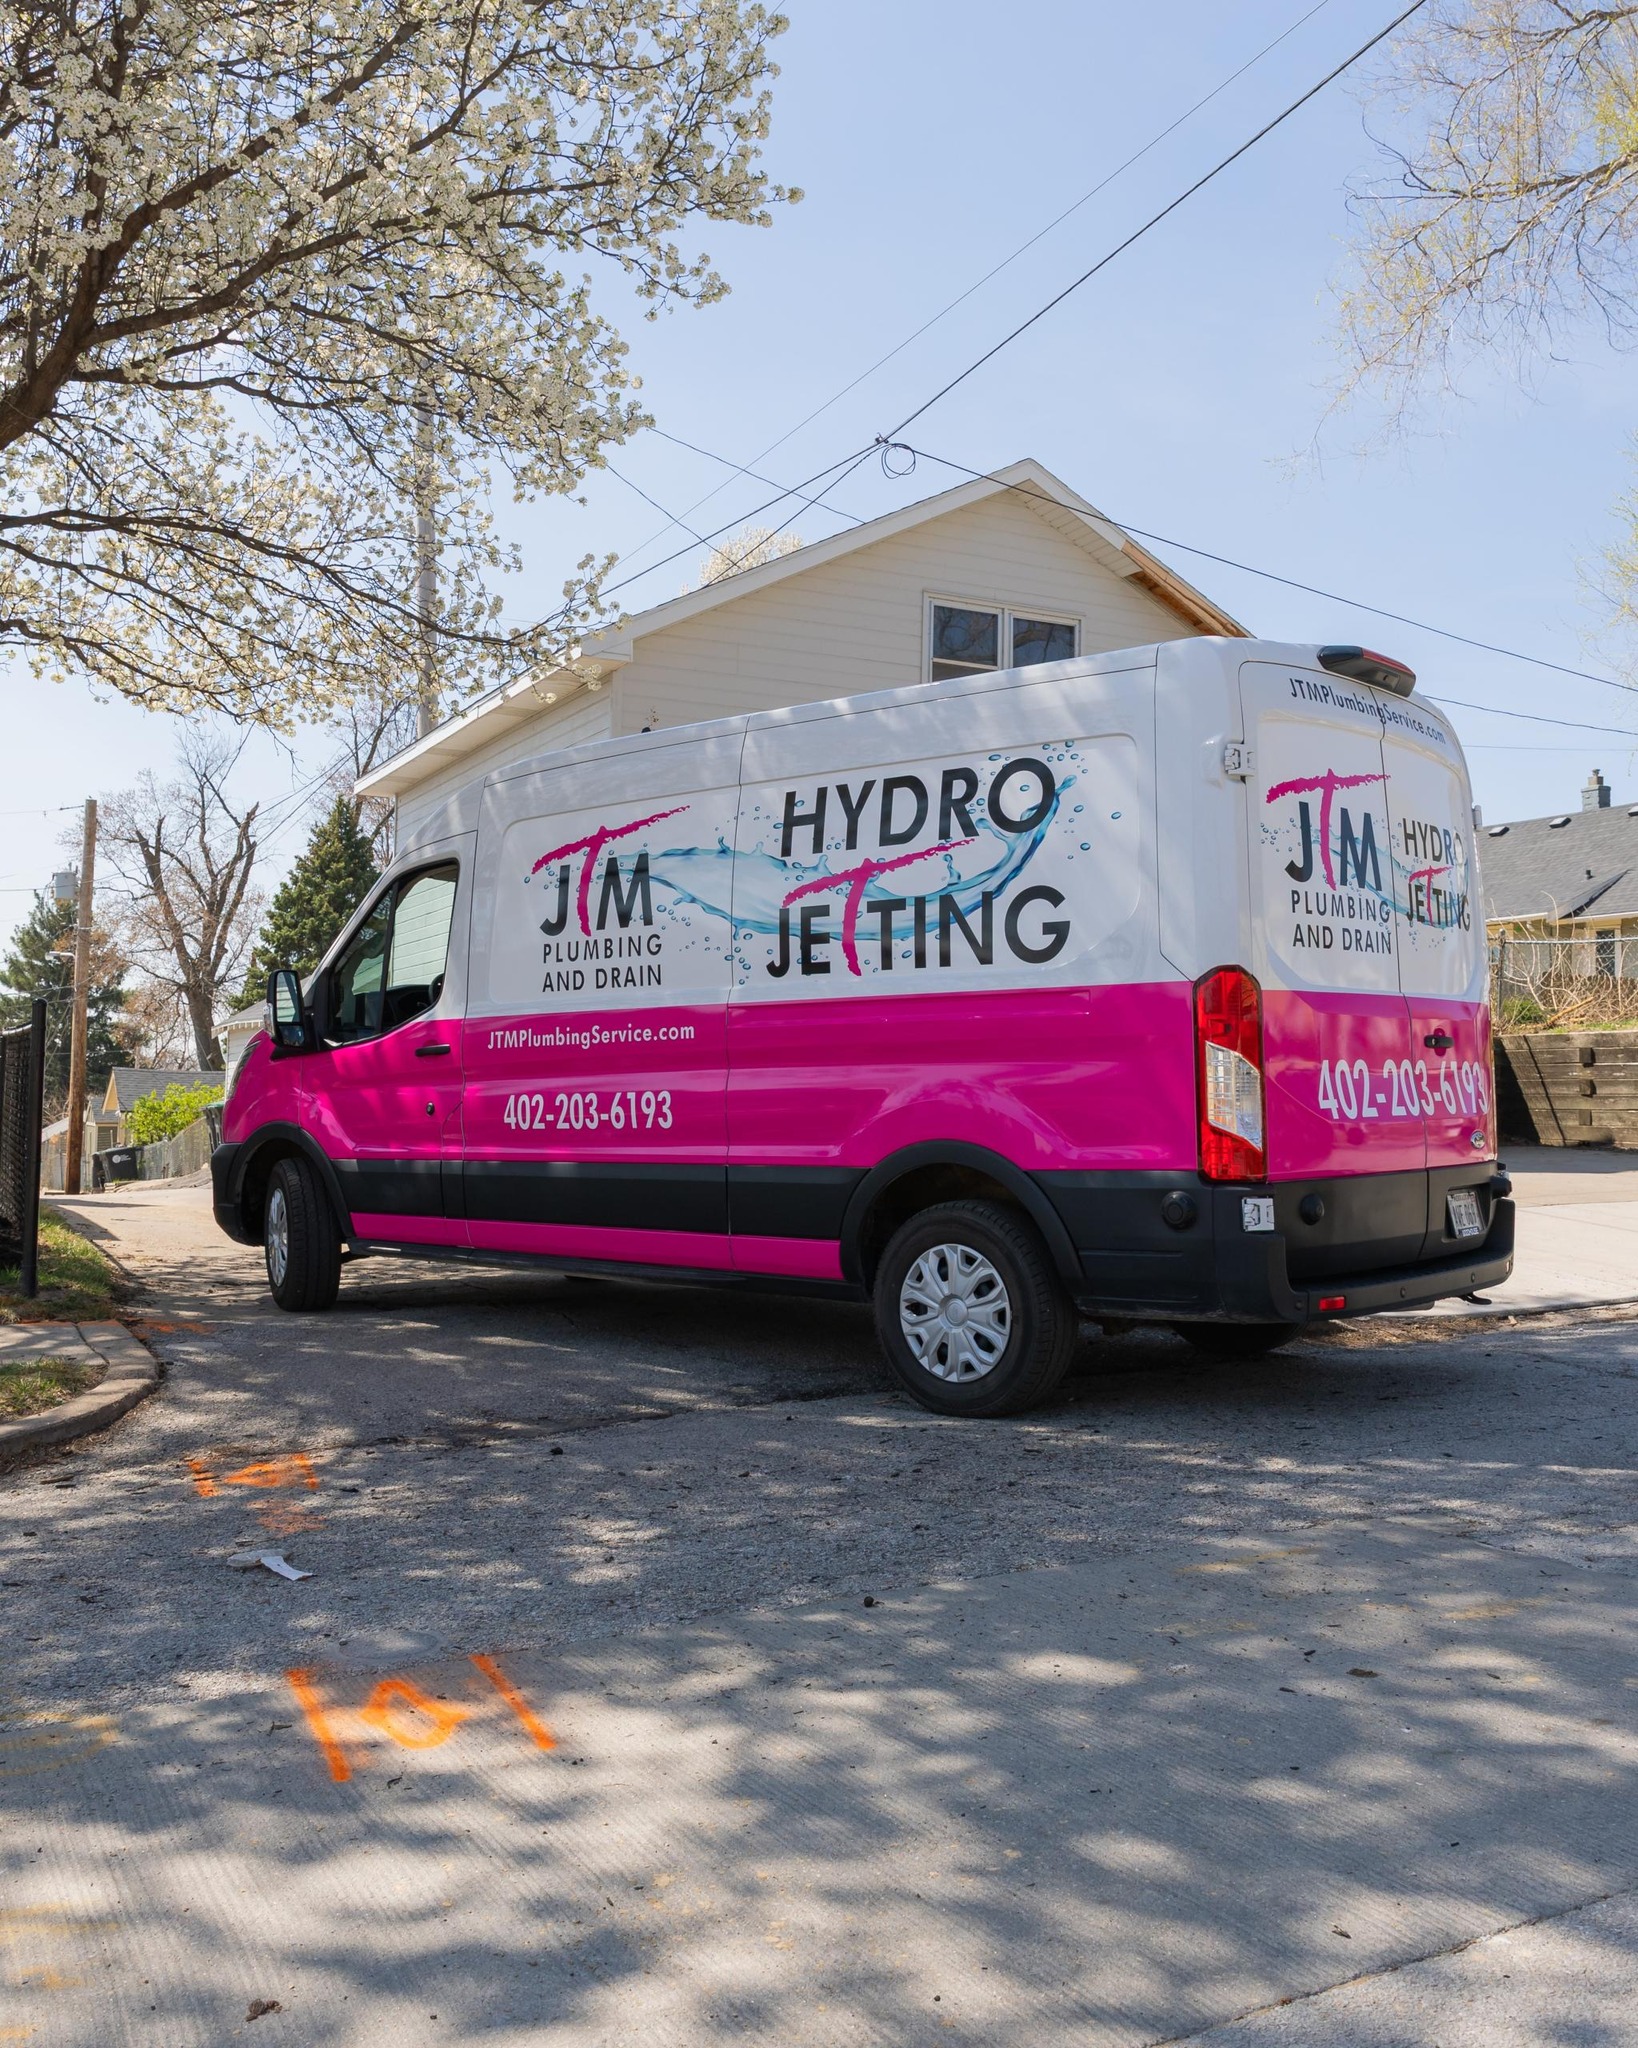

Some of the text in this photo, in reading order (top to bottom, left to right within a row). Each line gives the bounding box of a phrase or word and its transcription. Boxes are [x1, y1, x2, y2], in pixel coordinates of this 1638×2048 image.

[1289, 678, 1446, 744] JTMPlumbingService.com
[780, 757, 1056, 858] HYDRO
[1265, 768, 1392, 892] JTM
[531, 805, 691, 937] JTM
[1406, 865, 1471, 932] JETTING
[766, 838, 1071, 977] JETTING
[1291, 889, 1391, 923] PLUMBING
[543, 933, 662, 964] PLUMBING
[1292, 924, 1392, 955] AND DRAIN
[542, 964, 662, 993] AND DRAIN
[487, 1023, 695, 1050] JTMPlumbingService.com
[503, 1090, 674, 1131] 402-203-6193
[1317, 1058, 1490, 1121] 402-203-6193
